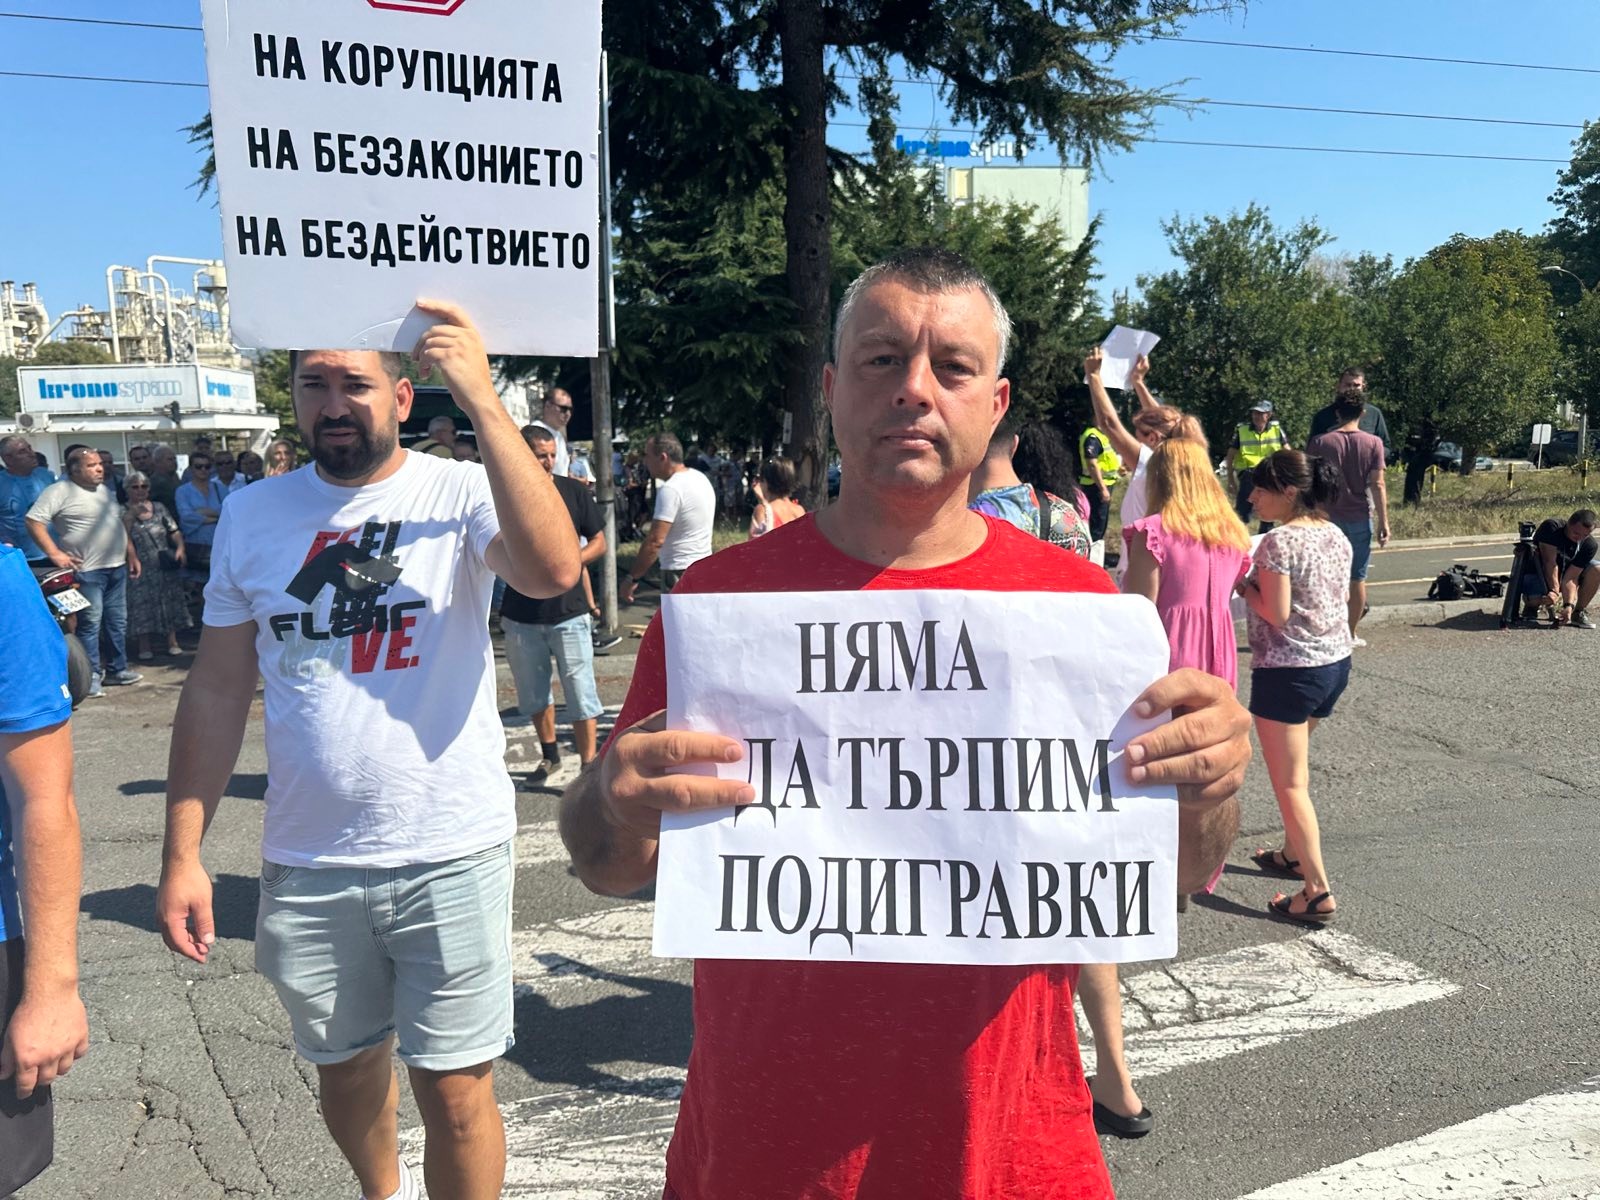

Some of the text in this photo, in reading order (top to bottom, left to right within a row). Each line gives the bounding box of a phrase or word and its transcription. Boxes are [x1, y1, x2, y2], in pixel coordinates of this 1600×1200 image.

[253, 33, 562, 103] НА КОРУПЦИЯТА
[247, 126, 583, 189] НА БЕЗЗАКОНИЕТО
[236, 214, 590, 270] НА БЕЗДЕЙСТВИЕТО
[38, 378, 182, 403] kronospan
[796, 620, 988, 693] НЯМА
[735, 737, 1120, 828] ДА ТЪРПИМ
[715, 854, 1155, 955] ПОДИГРАВКИ
